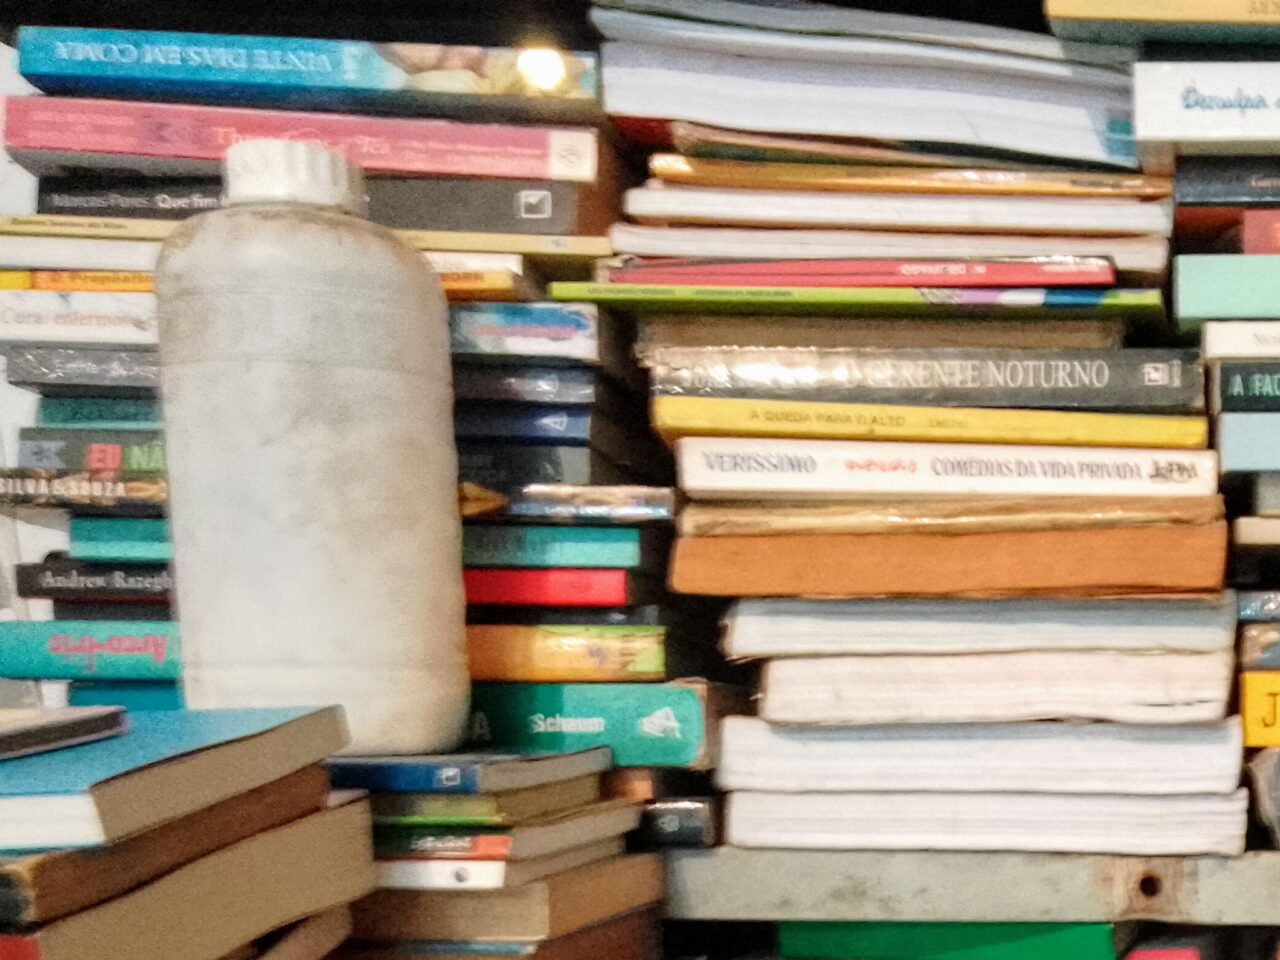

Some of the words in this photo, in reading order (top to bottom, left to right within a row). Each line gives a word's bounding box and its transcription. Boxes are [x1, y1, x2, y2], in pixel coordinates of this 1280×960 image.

[867, 359, 981, 388] GERENTE
[986, 359, 1110, 388] NOTURNO
[1229, 373, 1244, 397] A
[701, 450, 818, 474] VERISSIMO
[1040, 459, 1076, 479] VIDA
[1078, 460, 1144, 480] PRIVADA
